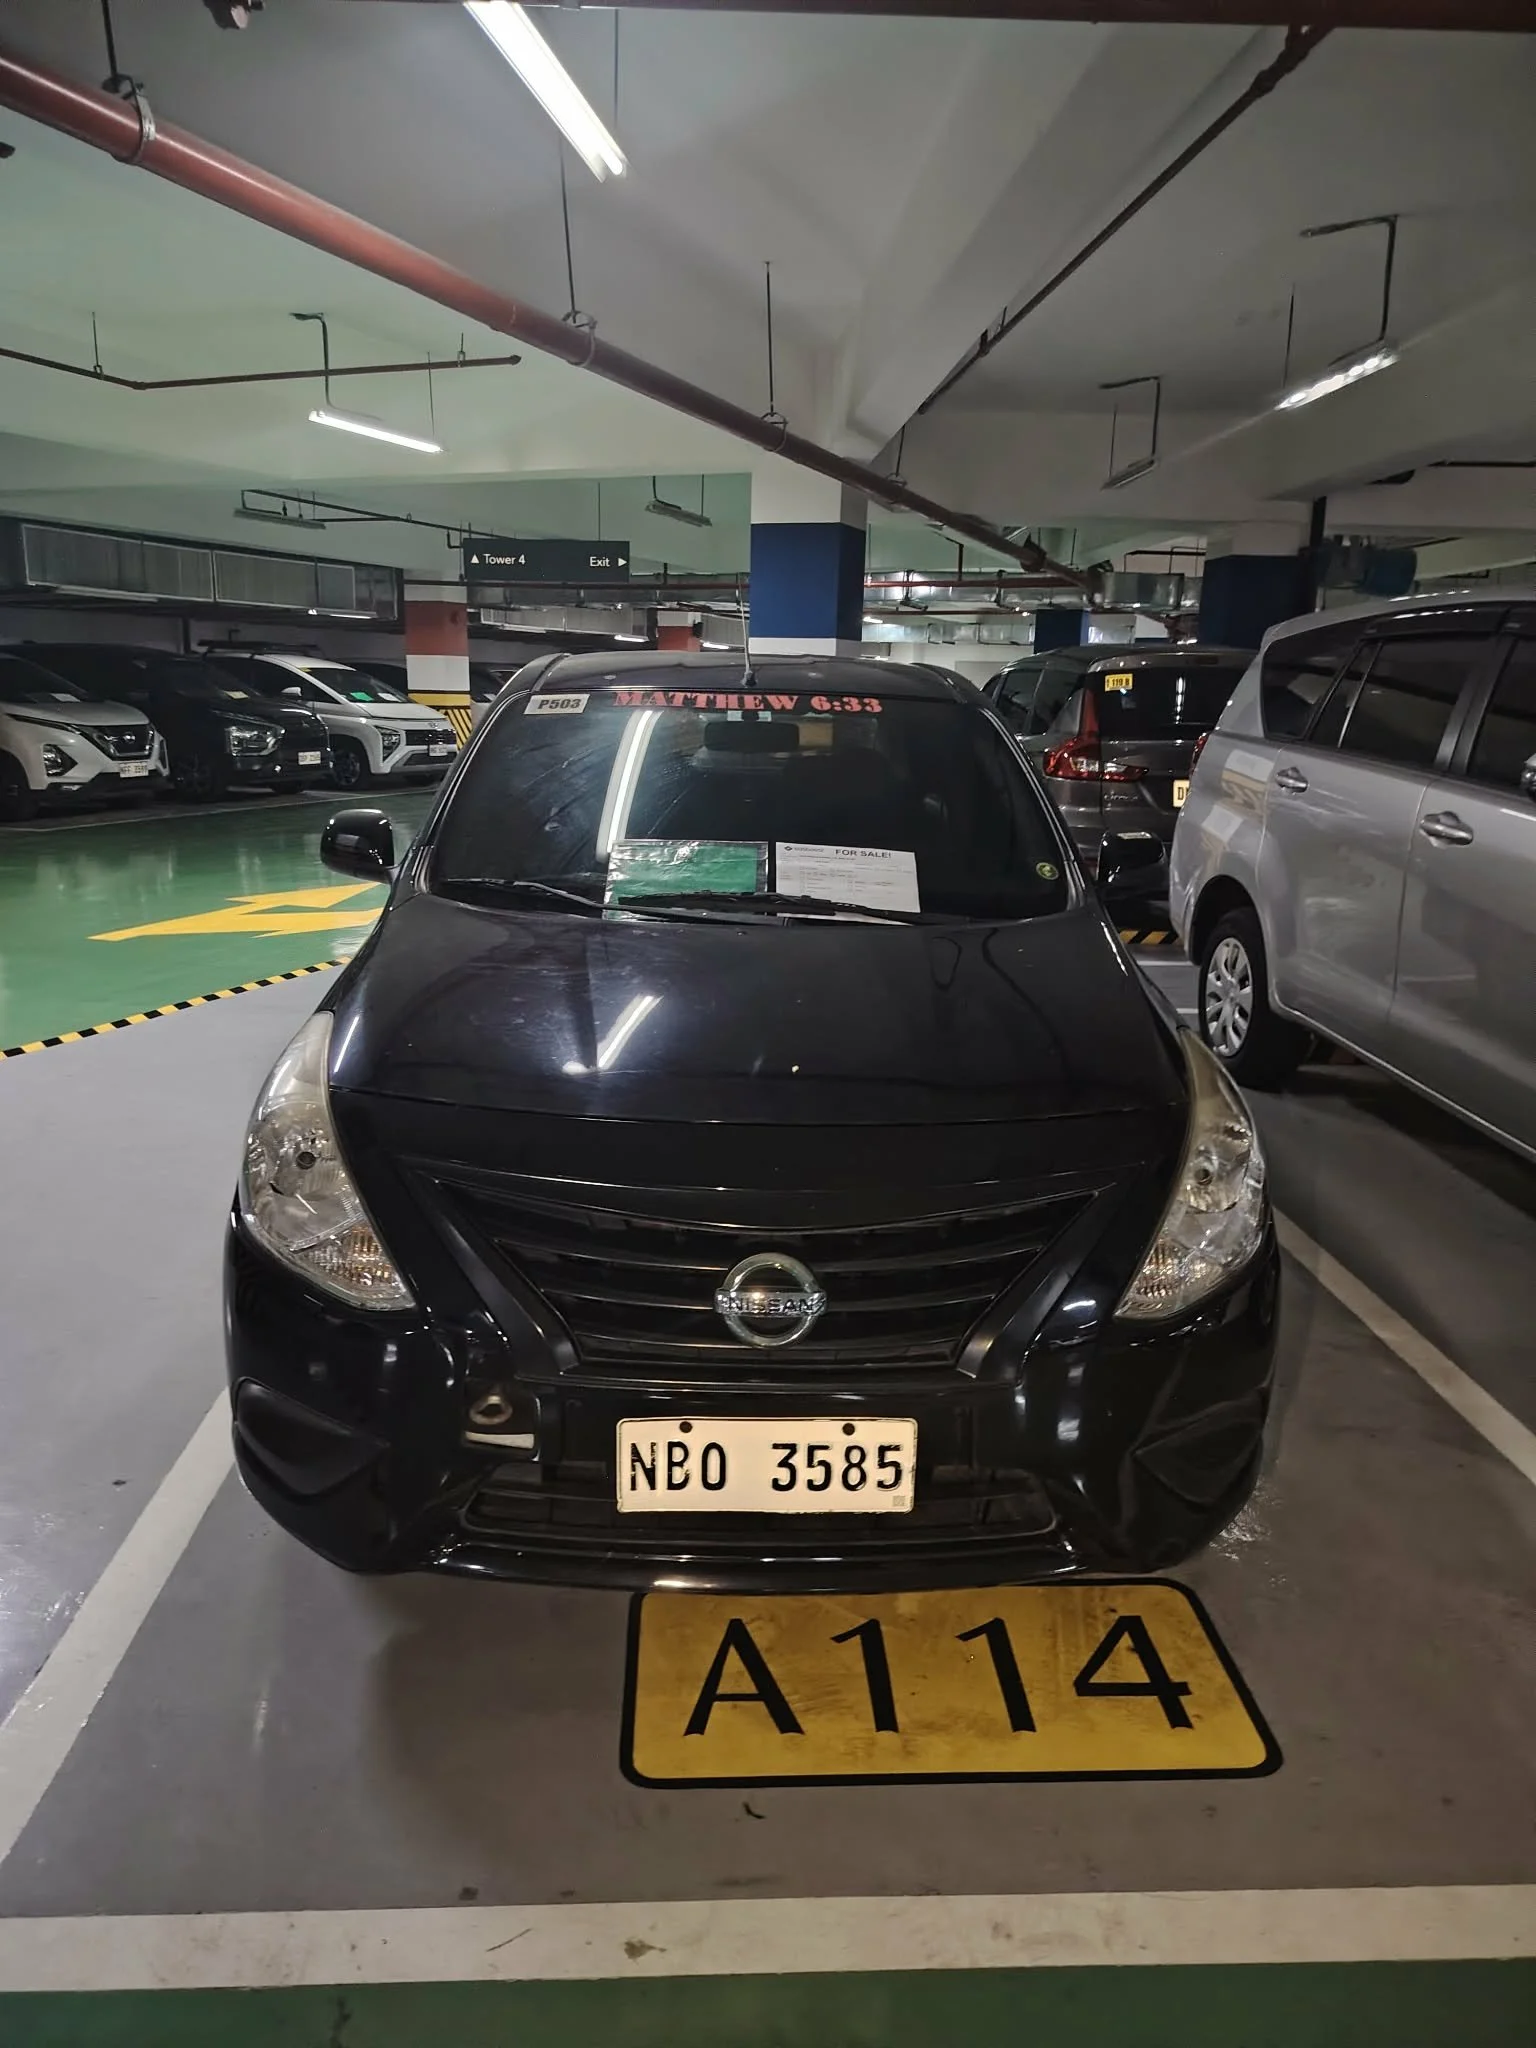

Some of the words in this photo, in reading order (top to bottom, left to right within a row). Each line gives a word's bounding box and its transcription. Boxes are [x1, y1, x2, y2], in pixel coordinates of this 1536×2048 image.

[483, 553, 516, 565] Tower
[518, 554, 526, 565] 4
[589, 556, 611, 567] Exit
[537, 698, 582, 710] P503
[612, 690, 799, 710] MATTHEW
[811, 695, 883, 712] 6:33
[835, 849, 858, 857] FOR
[859, 850, 892, 859] SALE!
[728, 1297, 813, 1313] NISSAN
[630, 1441, 726, 1492] NBO
[771, 1442, 903, 1492] 3585
[683, 1614, 1193, 1737] A114
